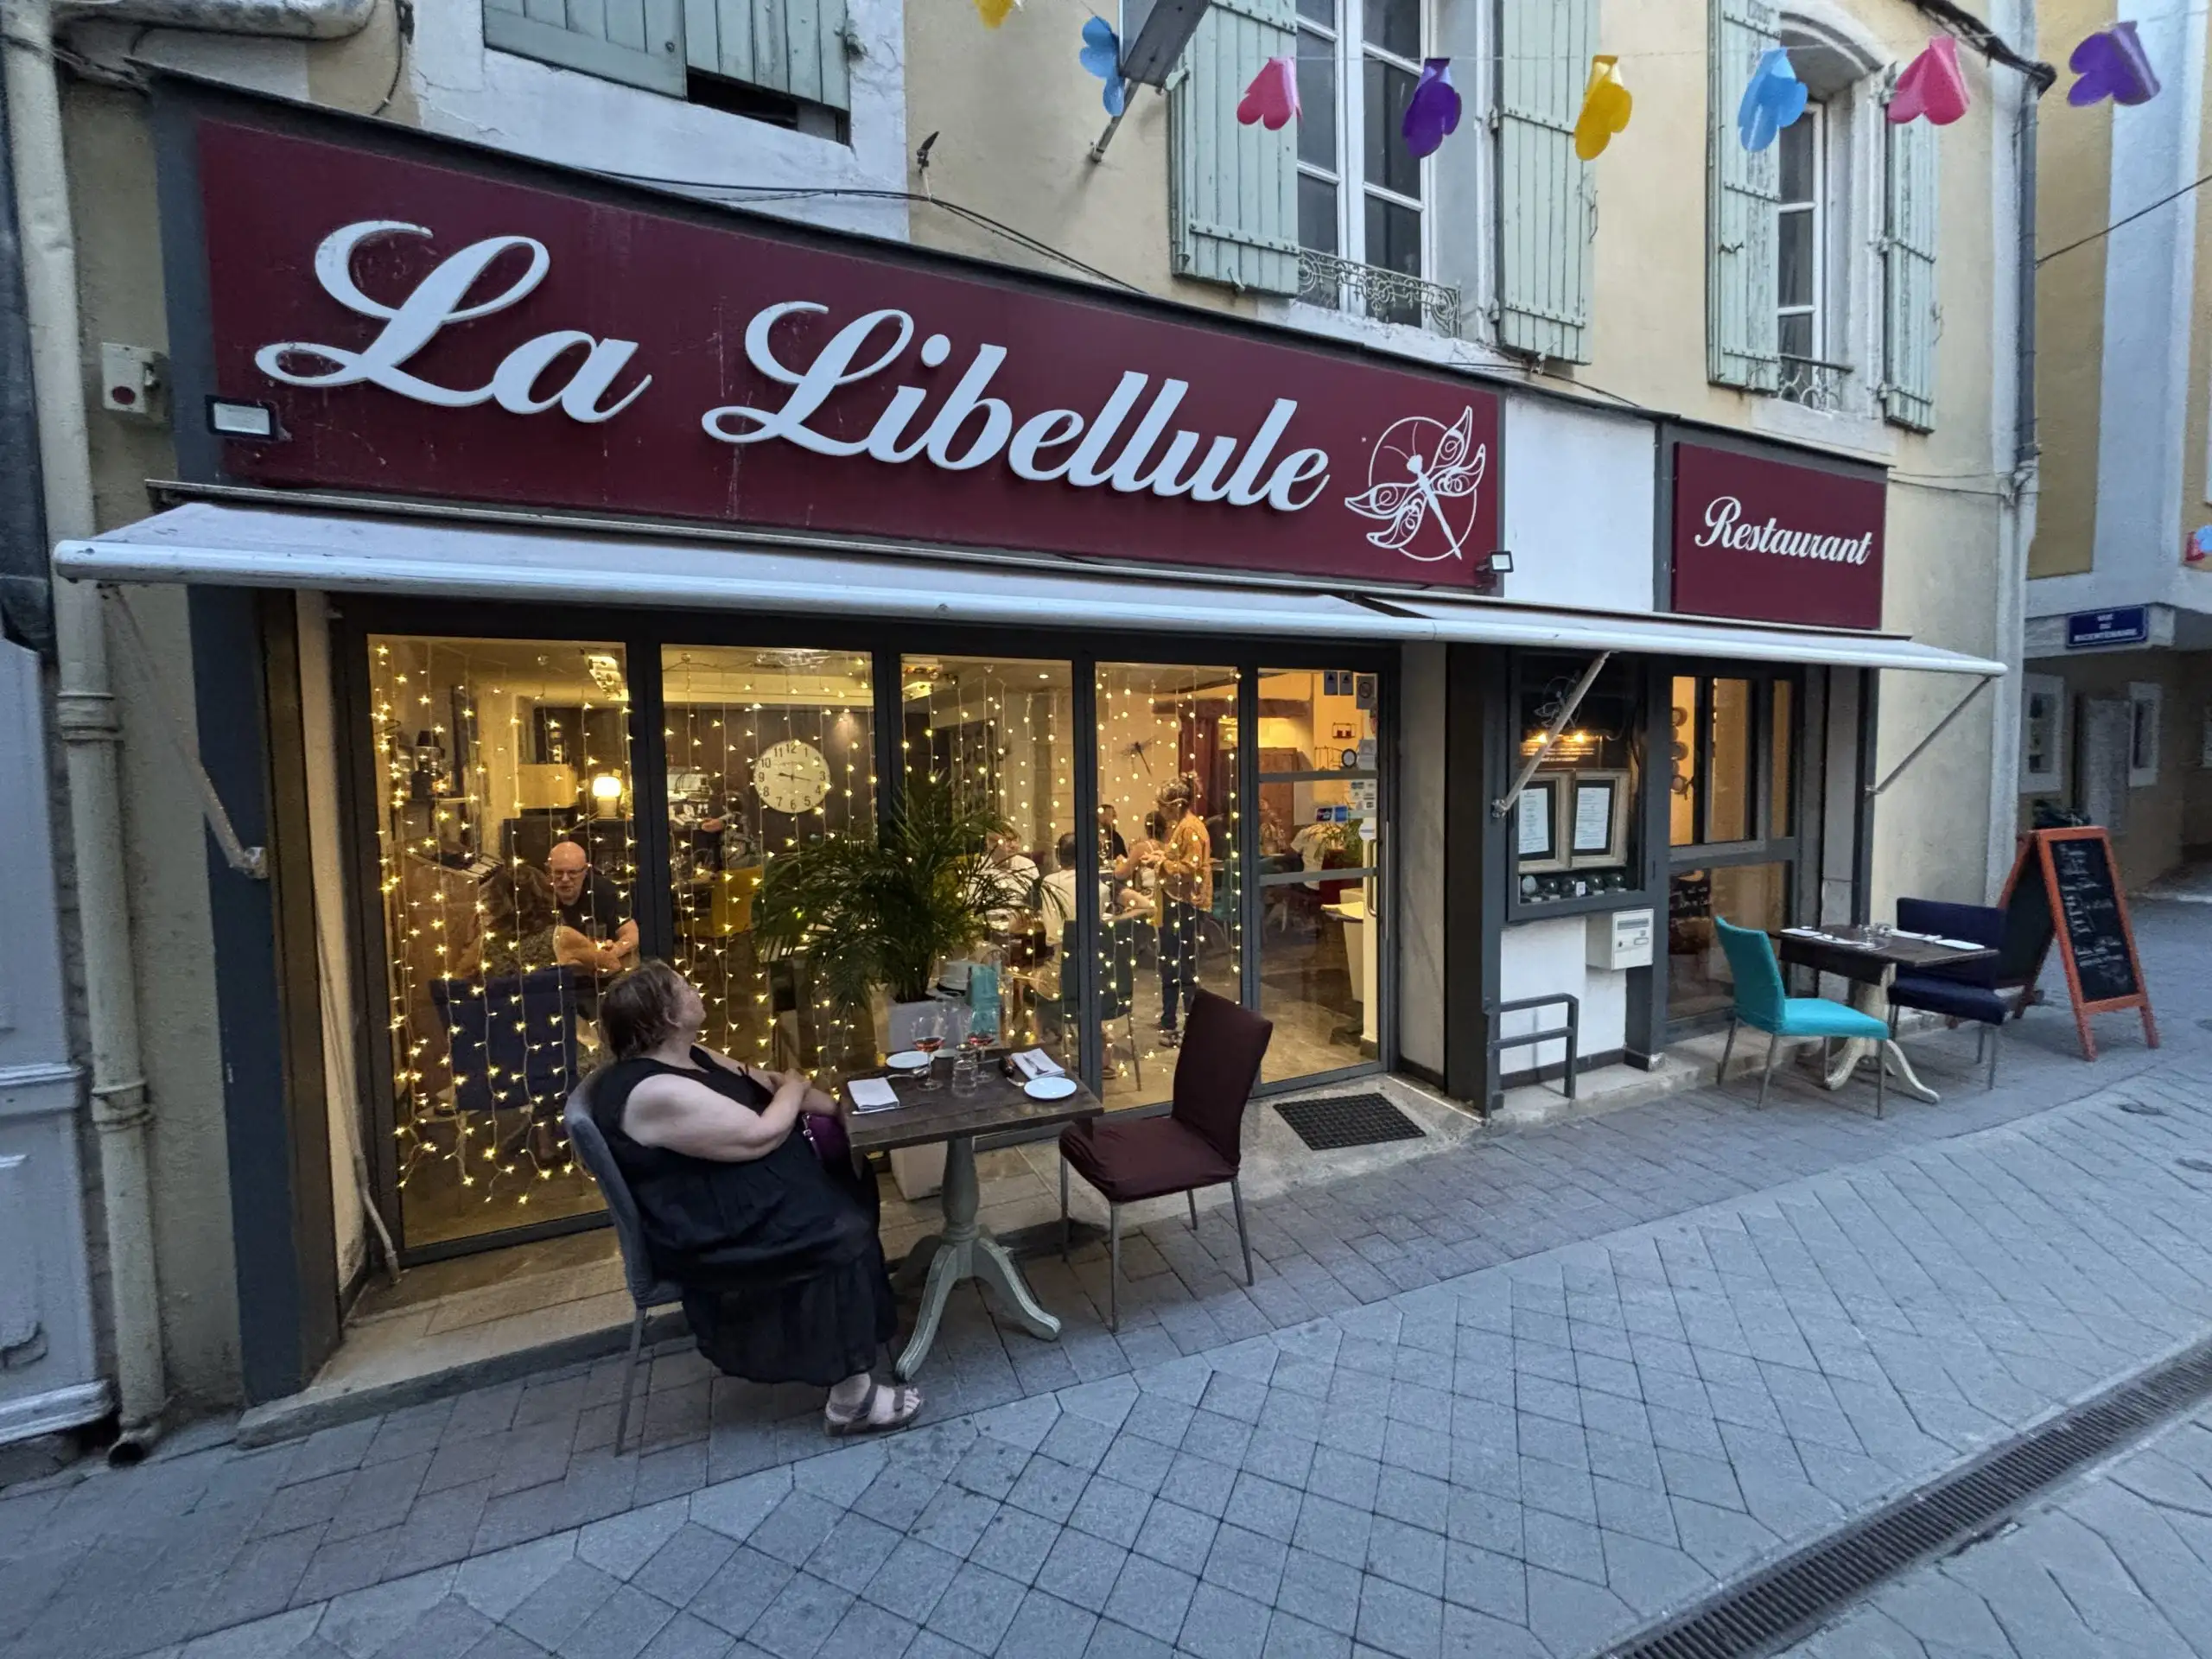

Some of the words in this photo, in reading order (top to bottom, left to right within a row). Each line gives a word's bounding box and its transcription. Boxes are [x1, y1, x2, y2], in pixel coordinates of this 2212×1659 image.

[254, 219, 653, 423] La
[701, 301, 1332, 512] Libellule
[1694, 495, 1874, 566] Restaurant
[774, 747, 783, 758] 11
[786, 743, 797, 753] 12
[761, 758, 771, 768] 10
[759, 772, 765, 783] 9
[819, 771, 826, 781] 3
[763, 786, 770, 797] 8
[815, 785, 821, 795] 4
[776, 797, 782, 806] 7
[790, 799, 797, 810] 6
[804, 796, 810, 806] 5
